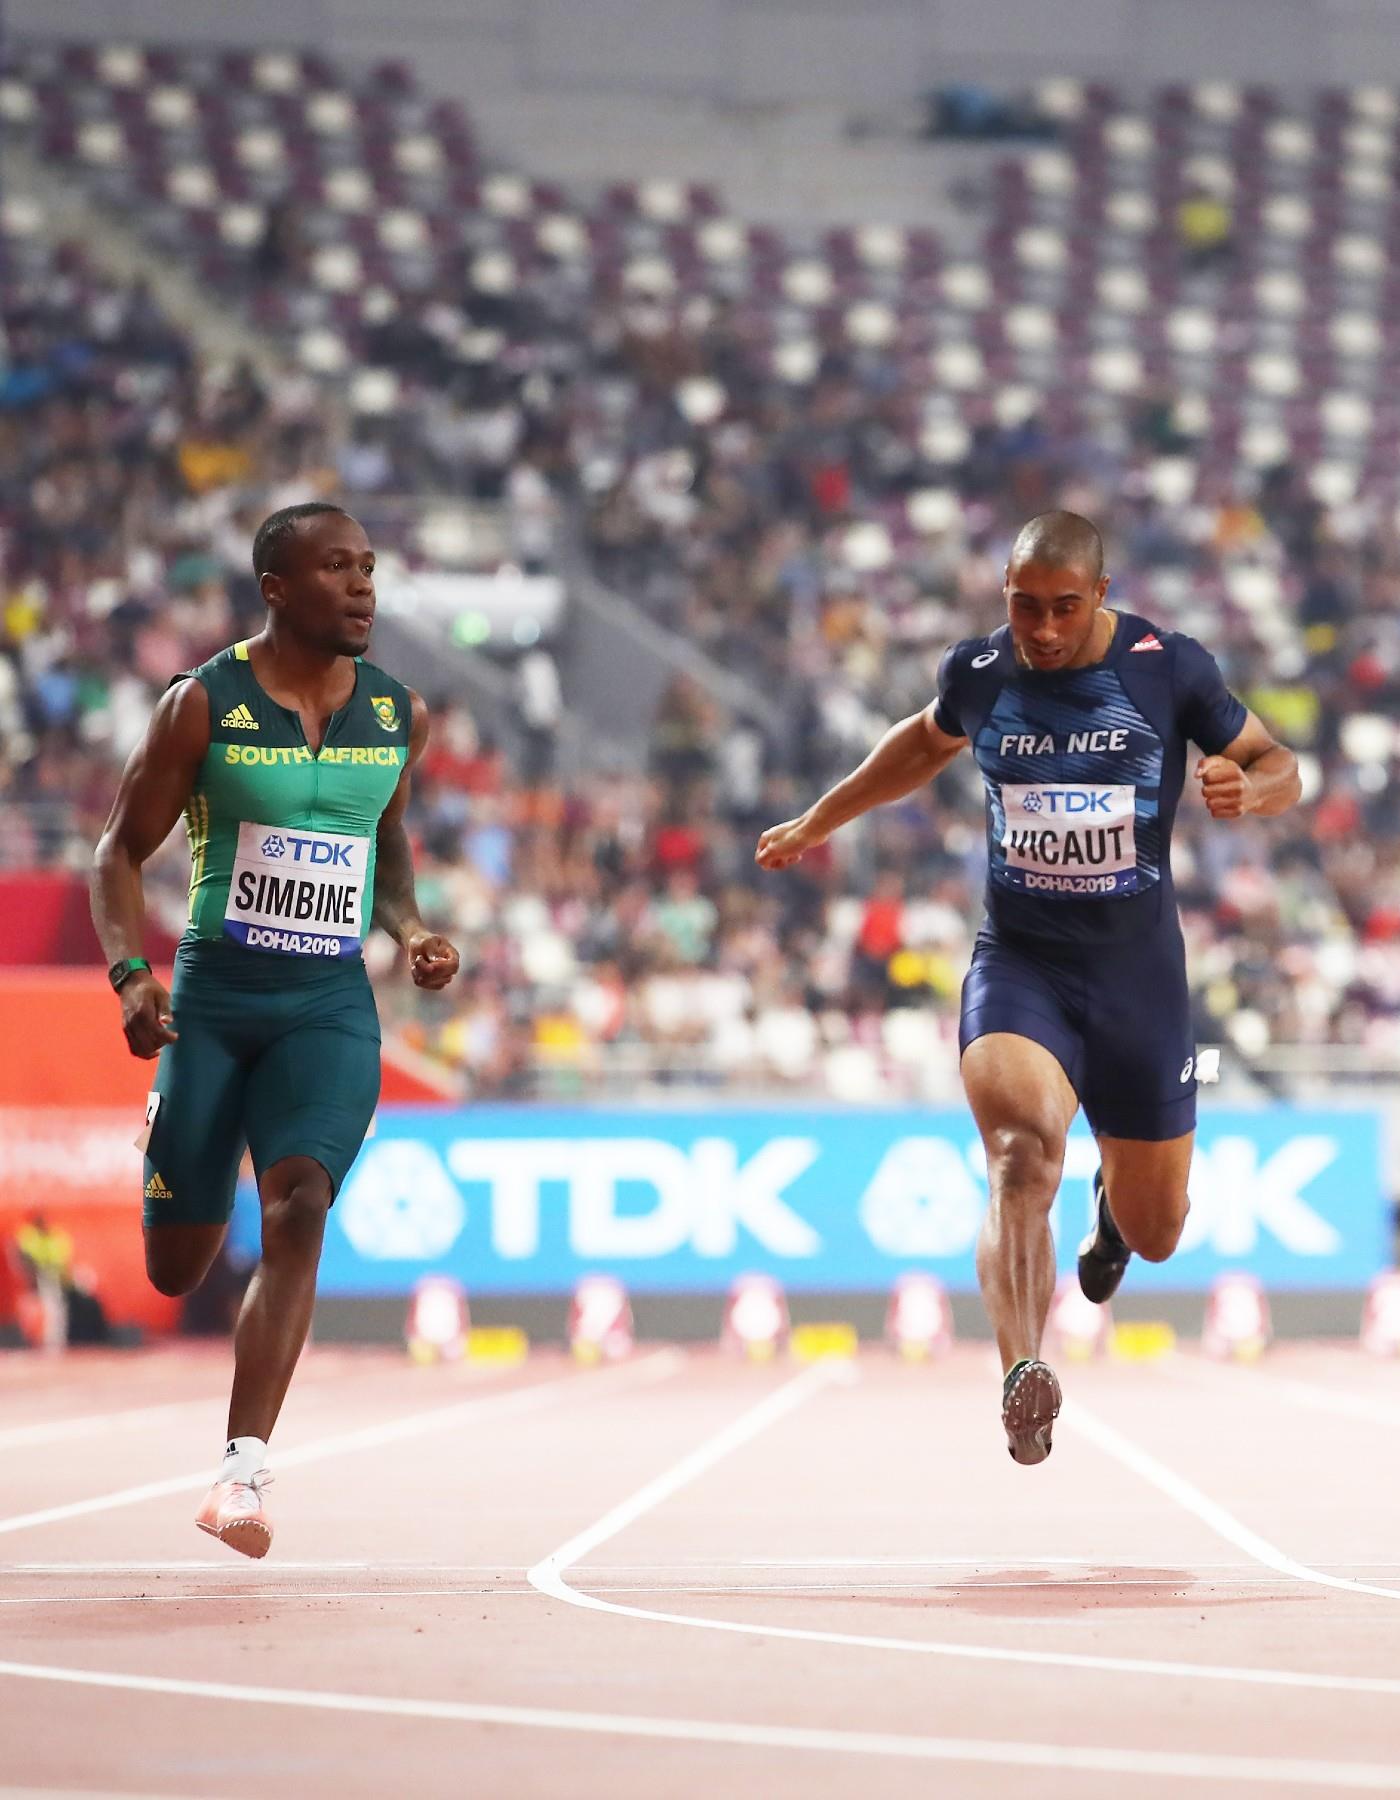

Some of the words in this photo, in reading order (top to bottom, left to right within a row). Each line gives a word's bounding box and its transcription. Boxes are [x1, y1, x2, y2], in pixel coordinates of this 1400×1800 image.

[221, 717, 260, 730] adidas
[224, 744, 314, 766] SOUTH
[317, 746, 400, 766] AFRICA
[1042, 791, 1113, 814] TDK
[287, 836, 355, 868] TDK
[1010, 825, 1126, 866] VICAUT
[235, 870, 357, 925] SIMBINE
[1024, 872, 1118, 893] DOHA2019
[246, 926, 342, 957] DOHA2019
[447, 1135, 822, 1262] TDK
